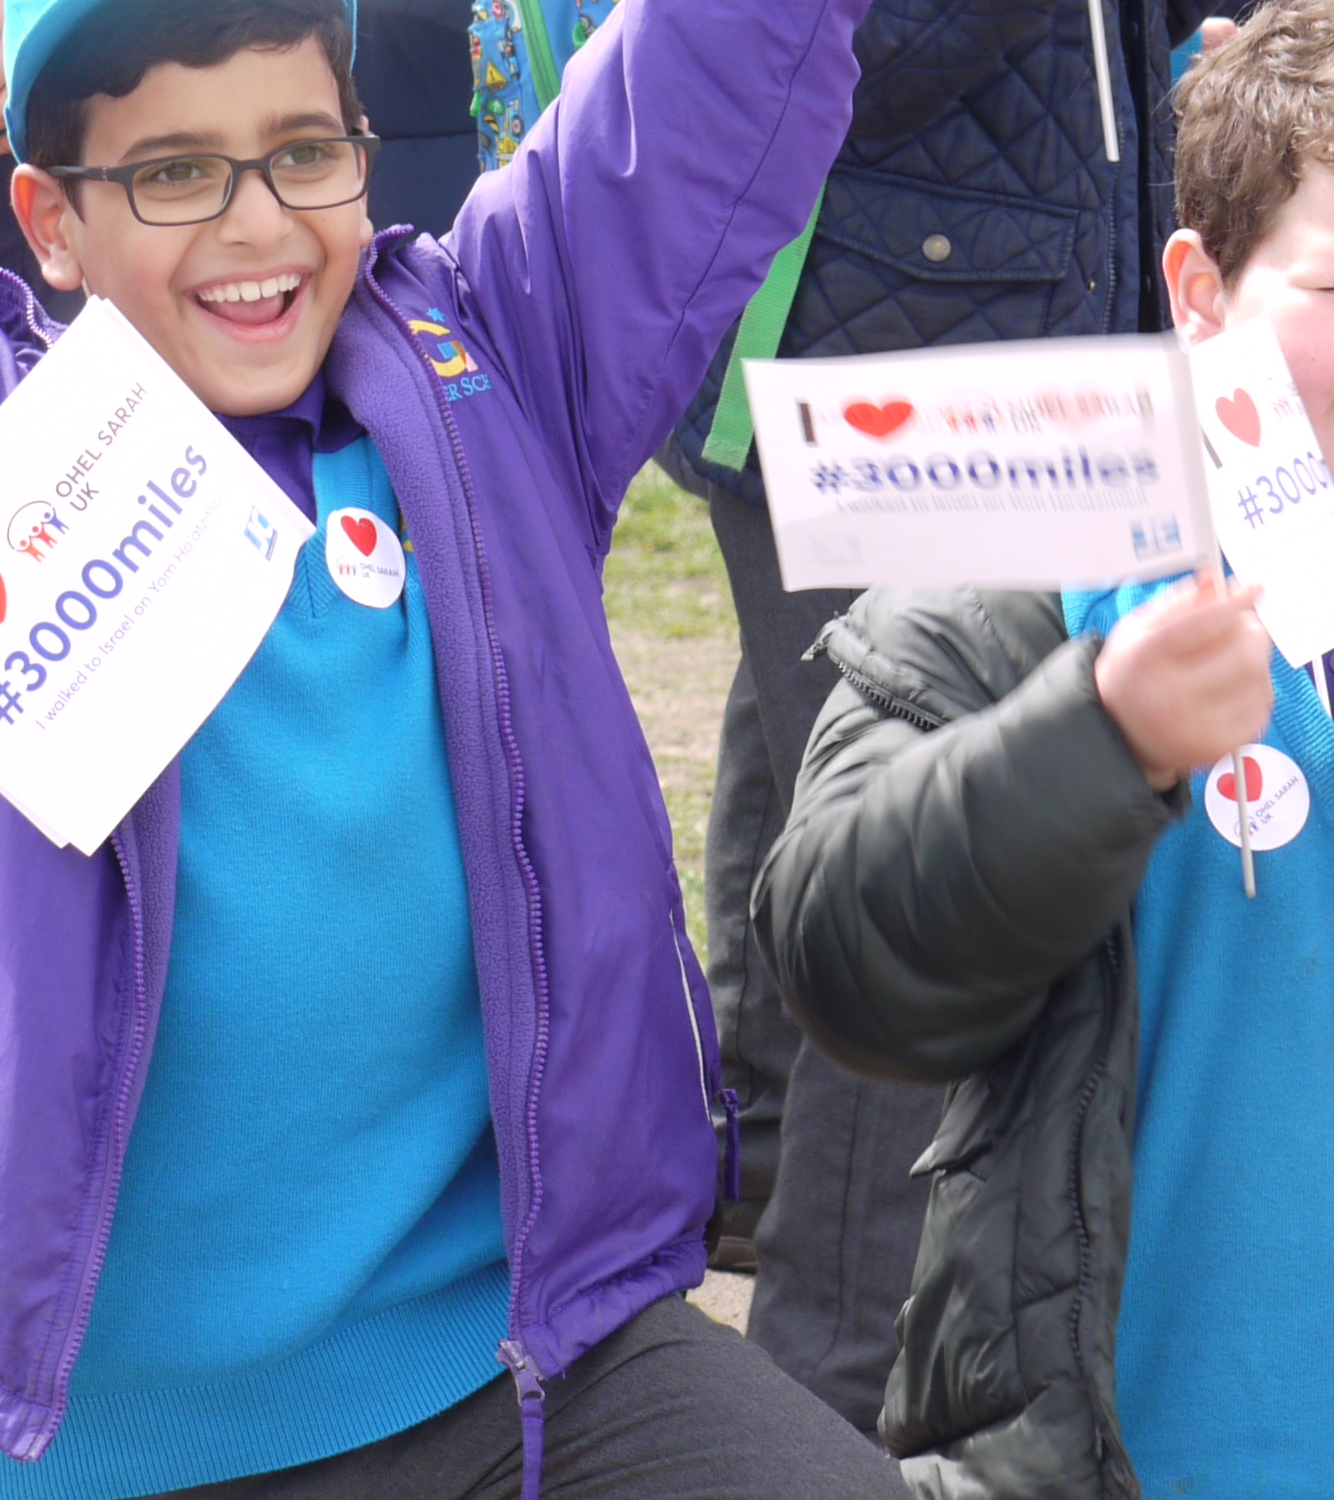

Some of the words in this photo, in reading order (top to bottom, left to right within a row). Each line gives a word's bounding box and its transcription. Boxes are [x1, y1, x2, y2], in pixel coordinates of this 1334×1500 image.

[56, 449, 103, 498] OHEL
[97, 382, 147, 447] SARAH
[794, 397, 819, 447] I
[812, 444, 1161, 496] #3000miles
[69, 481, 100, 512] UK
[35, 720, 47, 730] I
[44, 669, 88, 722] walked
[84, 655, 102, 674] to
[97, 613, 136, 656] Israel
[133, 594, 153, 616] on
[147, 561, 178, 594] Yom
[1256, 799, 1276, 818] OHEL
[1273, 776, 1300, 800] SARAH
[1260, 812, 1274, 825] UK
